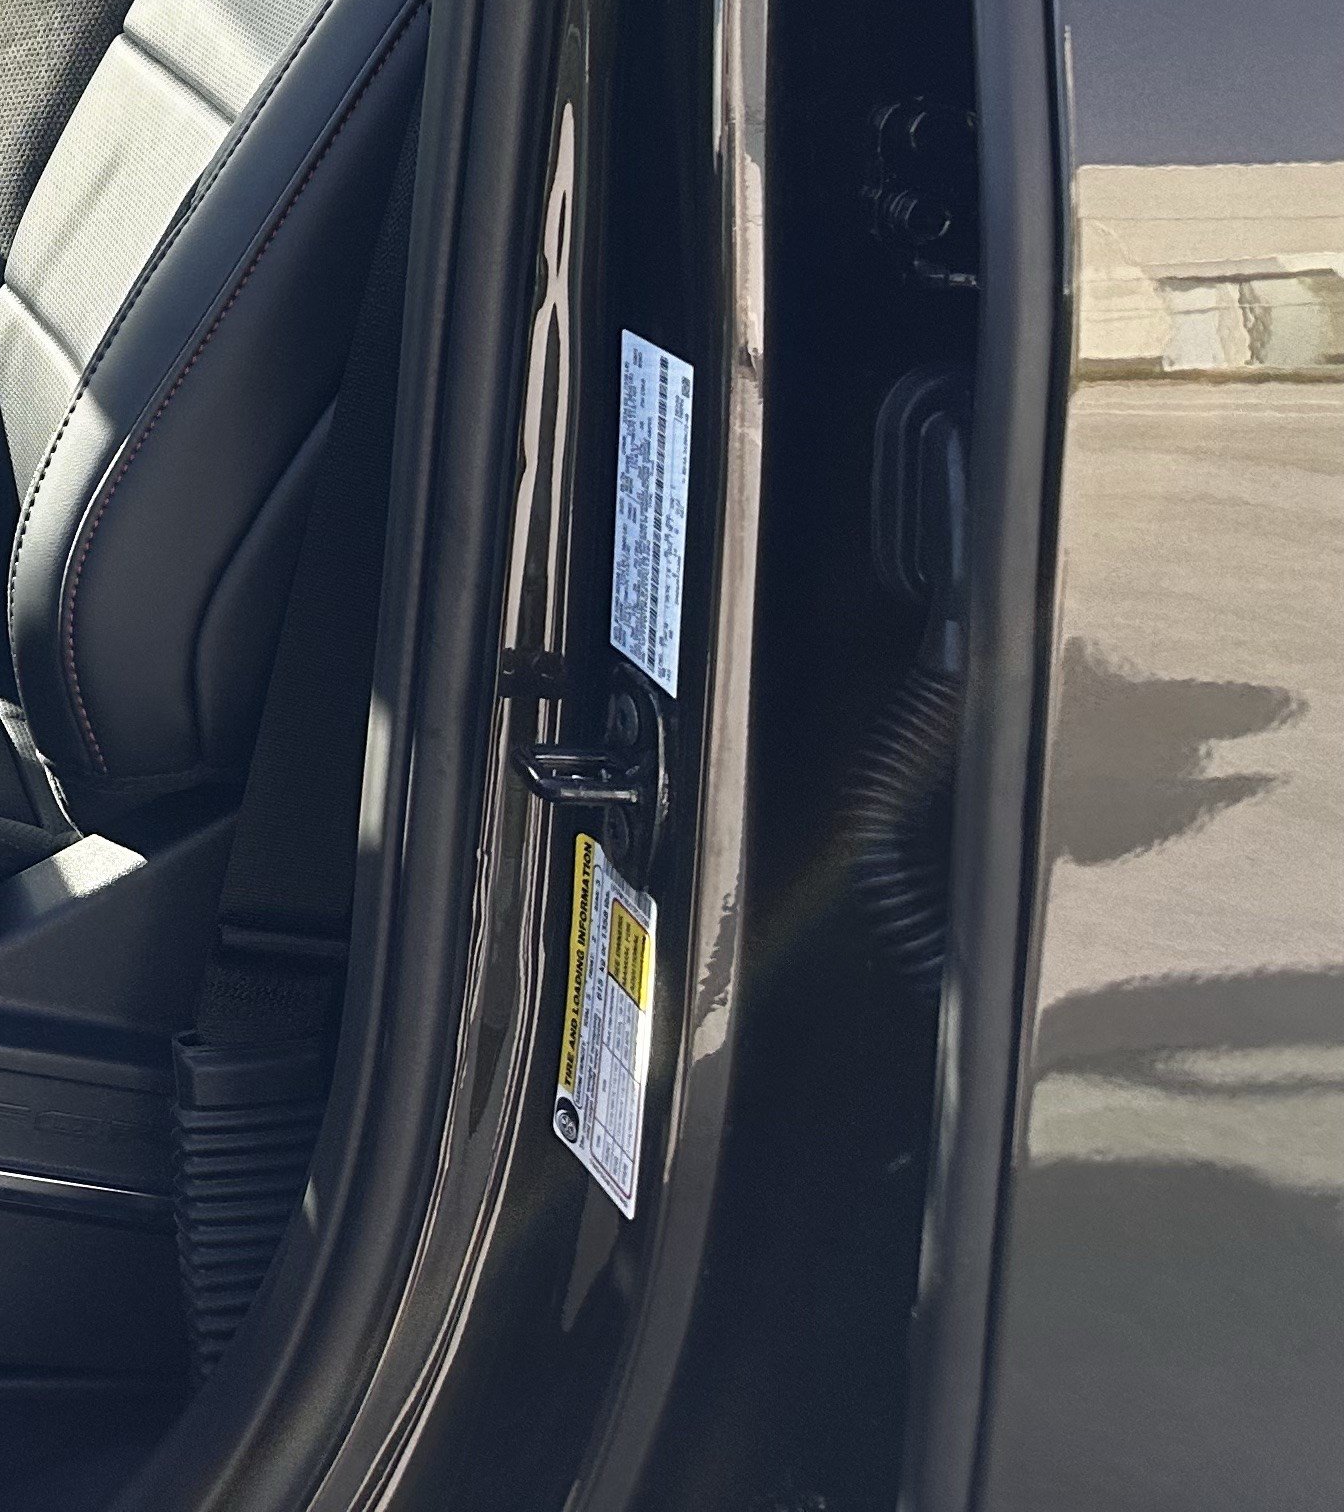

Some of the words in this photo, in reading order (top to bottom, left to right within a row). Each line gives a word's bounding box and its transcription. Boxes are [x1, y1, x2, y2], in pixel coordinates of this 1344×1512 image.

[577, 841, 592, 947] INFORMATION
[571, 948, 585, 1017] LOADING
[568, 1017, 578, 1050] AND
[564, 1051, 575, 1087] TIRE
